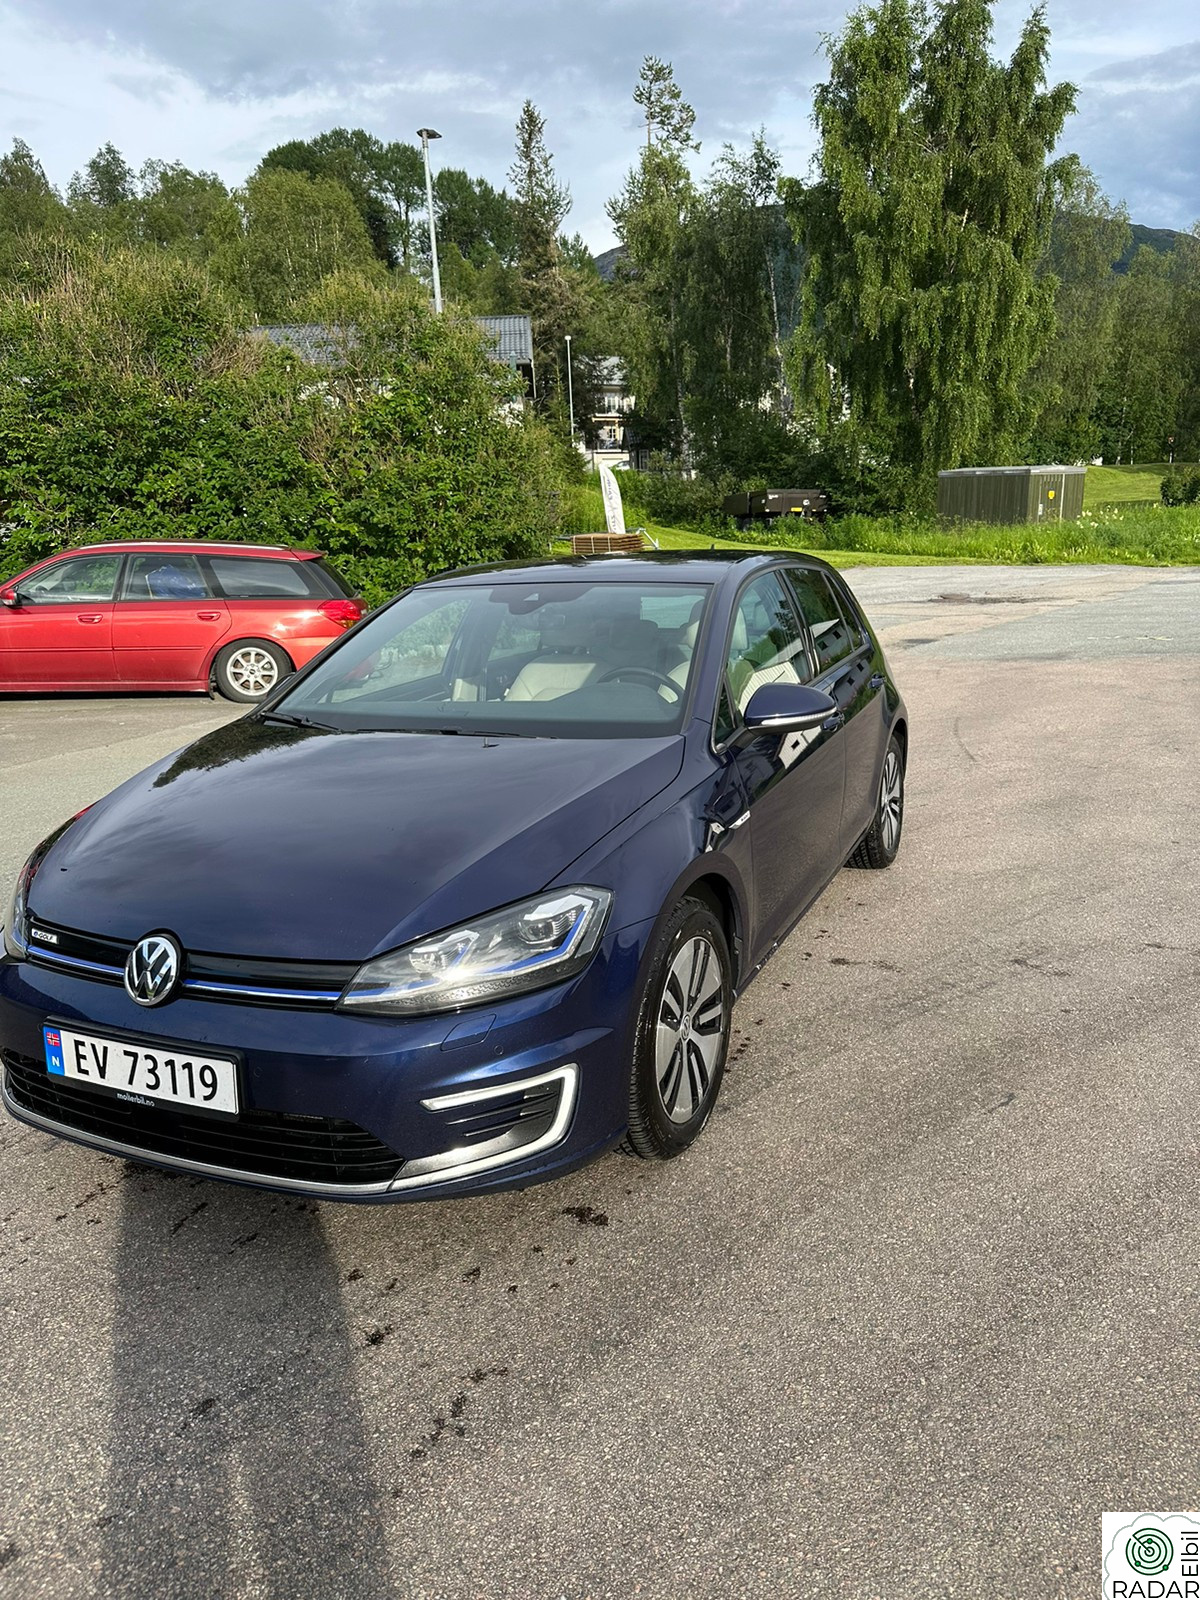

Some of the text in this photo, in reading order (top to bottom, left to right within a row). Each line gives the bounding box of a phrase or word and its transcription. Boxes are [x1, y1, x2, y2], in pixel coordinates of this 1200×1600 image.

[51, 1055, 61, 1067] N
[73, 1039, 218, 1101] EV 73119
